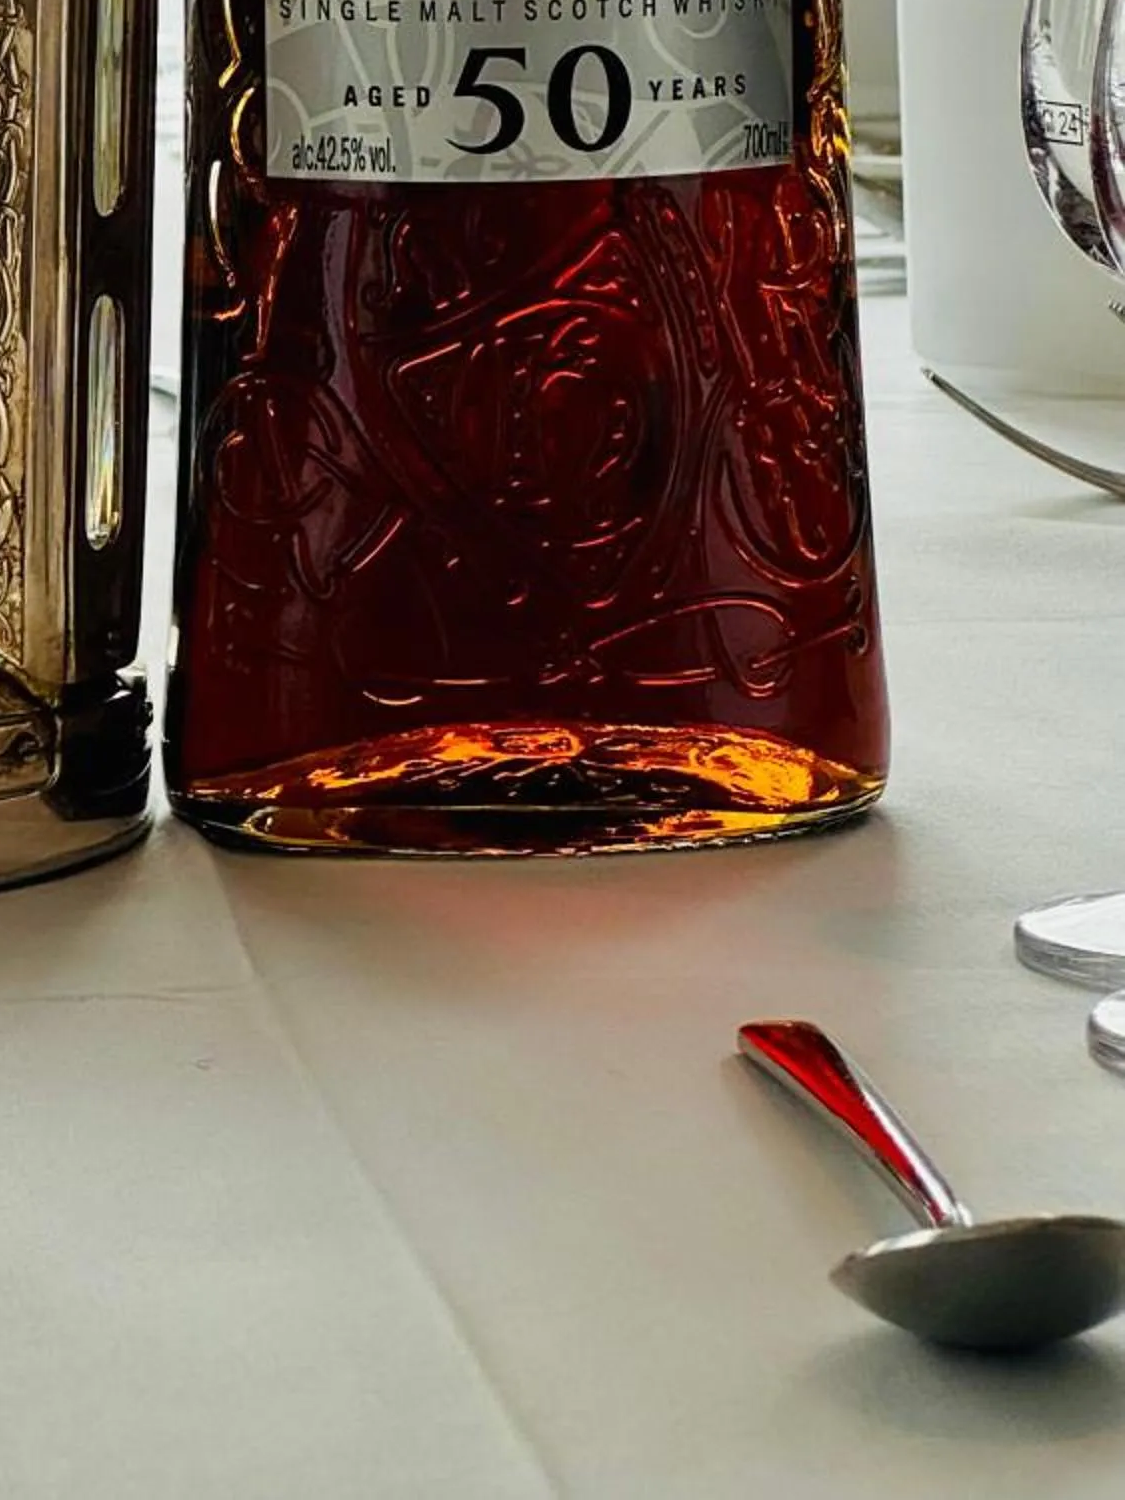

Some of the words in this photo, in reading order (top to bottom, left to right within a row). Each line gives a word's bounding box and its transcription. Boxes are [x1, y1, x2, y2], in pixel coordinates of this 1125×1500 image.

[279, 0, 401, 22] SINGLE
[420, 0, 506, 22] MALT
[343, 85, 432, 108] AGED
[445, 45, 632, 155] 50
[649, 74, 747, 101] YEARS
[369, 138, 396, 173] vol.
